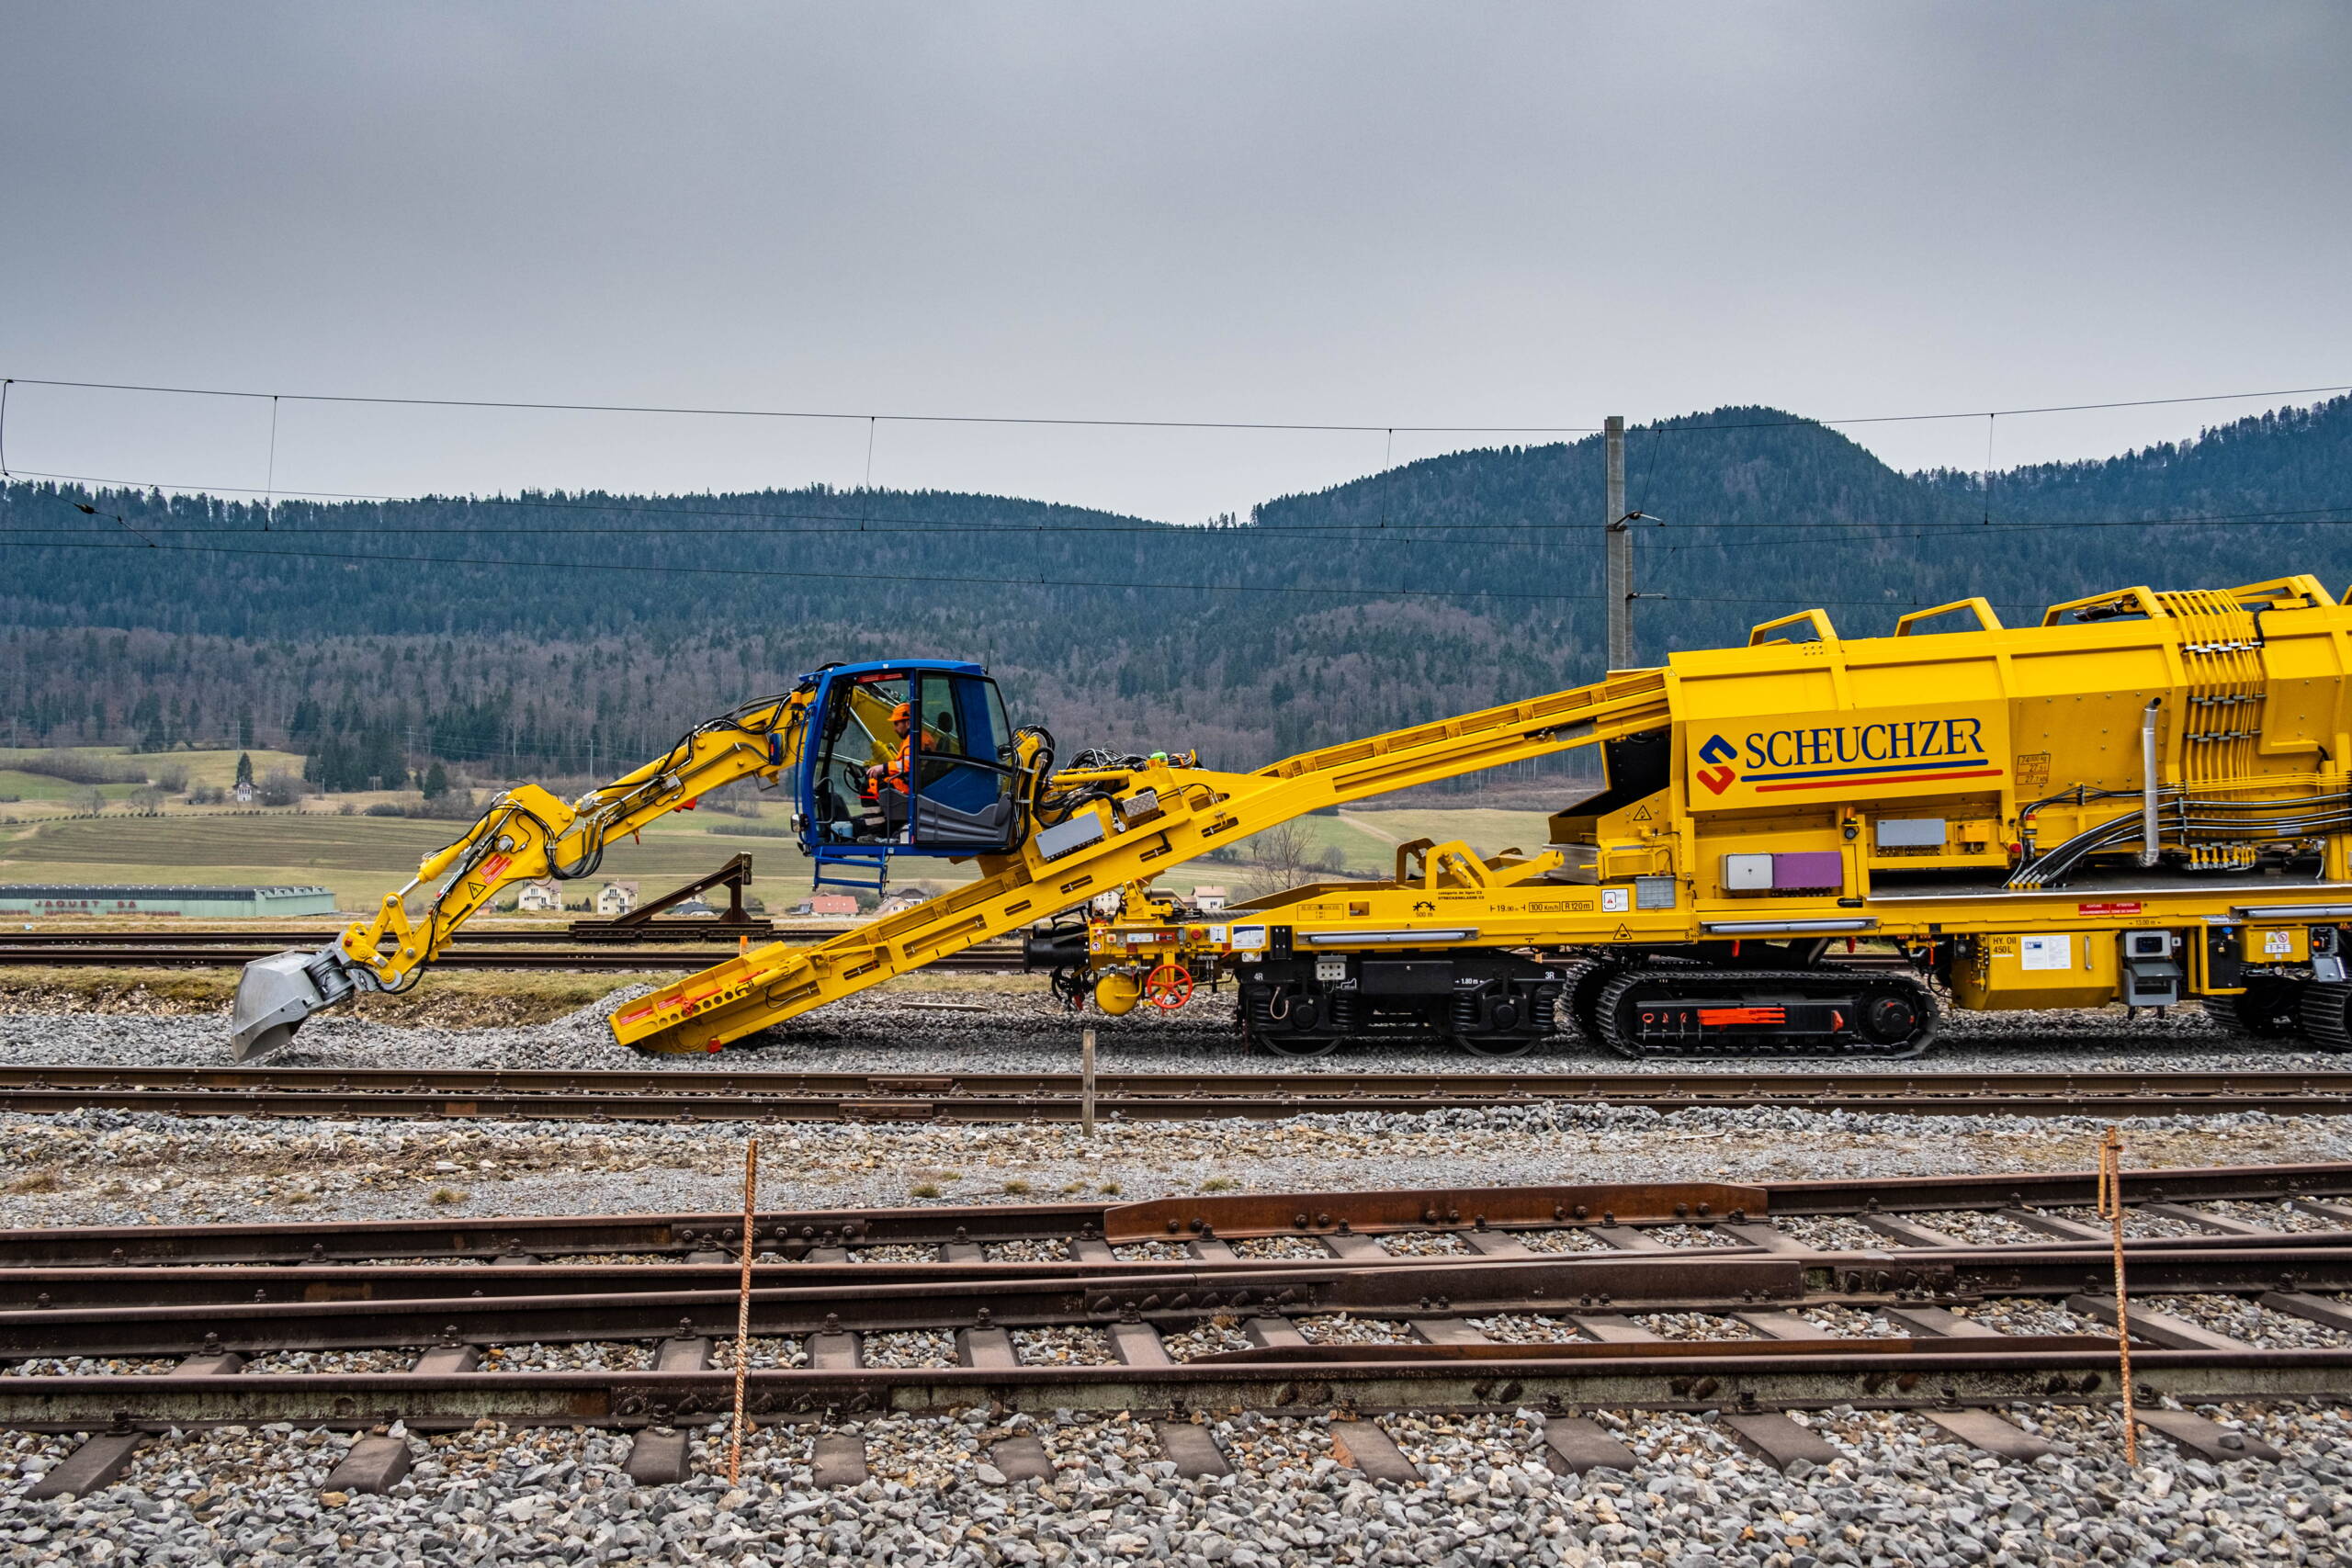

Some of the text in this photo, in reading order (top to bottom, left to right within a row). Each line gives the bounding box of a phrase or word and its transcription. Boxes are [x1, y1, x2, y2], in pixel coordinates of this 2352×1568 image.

[1746, 717, 1985, 770] SCHEUCHZER
[1531, 903, 1544, 911] 100
[1571, 902, 1582, 910] 120
[1253, 972, 1263, 982] 4R
[1544, 971, 1555, 980] 3R
